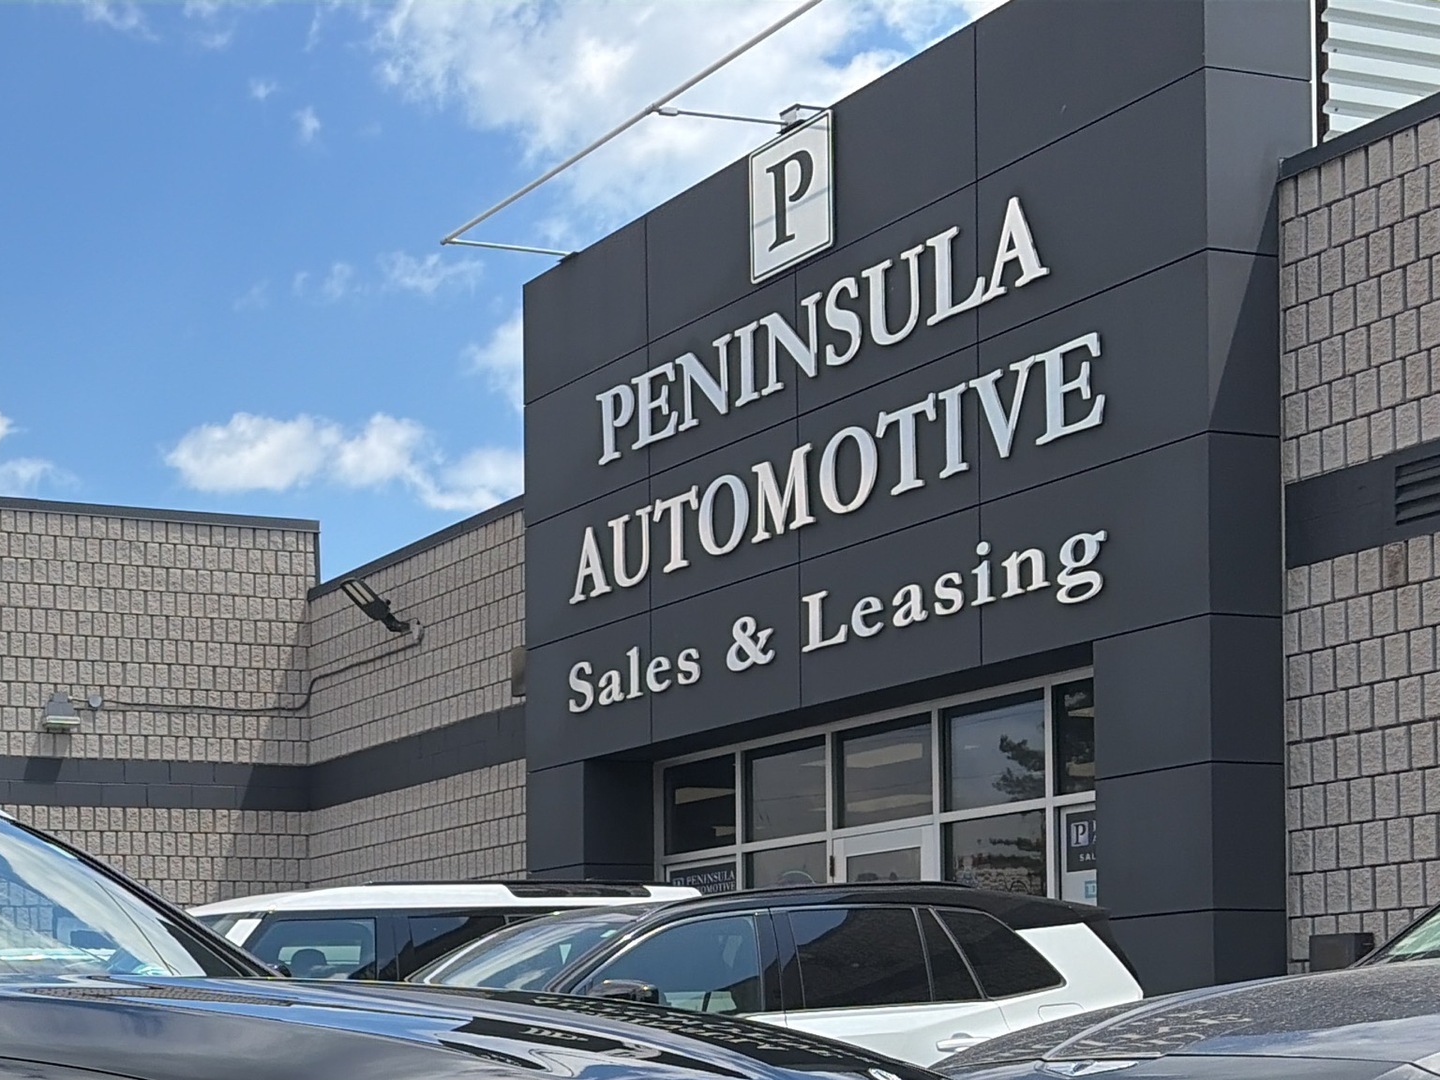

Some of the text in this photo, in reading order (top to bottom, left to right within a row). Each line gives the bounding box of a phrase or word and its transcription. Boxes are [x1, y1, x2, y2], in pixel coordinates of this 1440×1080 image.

[766, 150, 815, 253] P
[595, 196, 1050, 466] PENINSULA
[569, 332, 1106, 605] AUTOMOTIVE
[569, 530, 1107, 713] Sales & Leasing
[686, 870, 735, 886] PENINSULA
[696, 881, 735, 894] OMOTIVE
[1079, 852, 1097, 861] SAL
